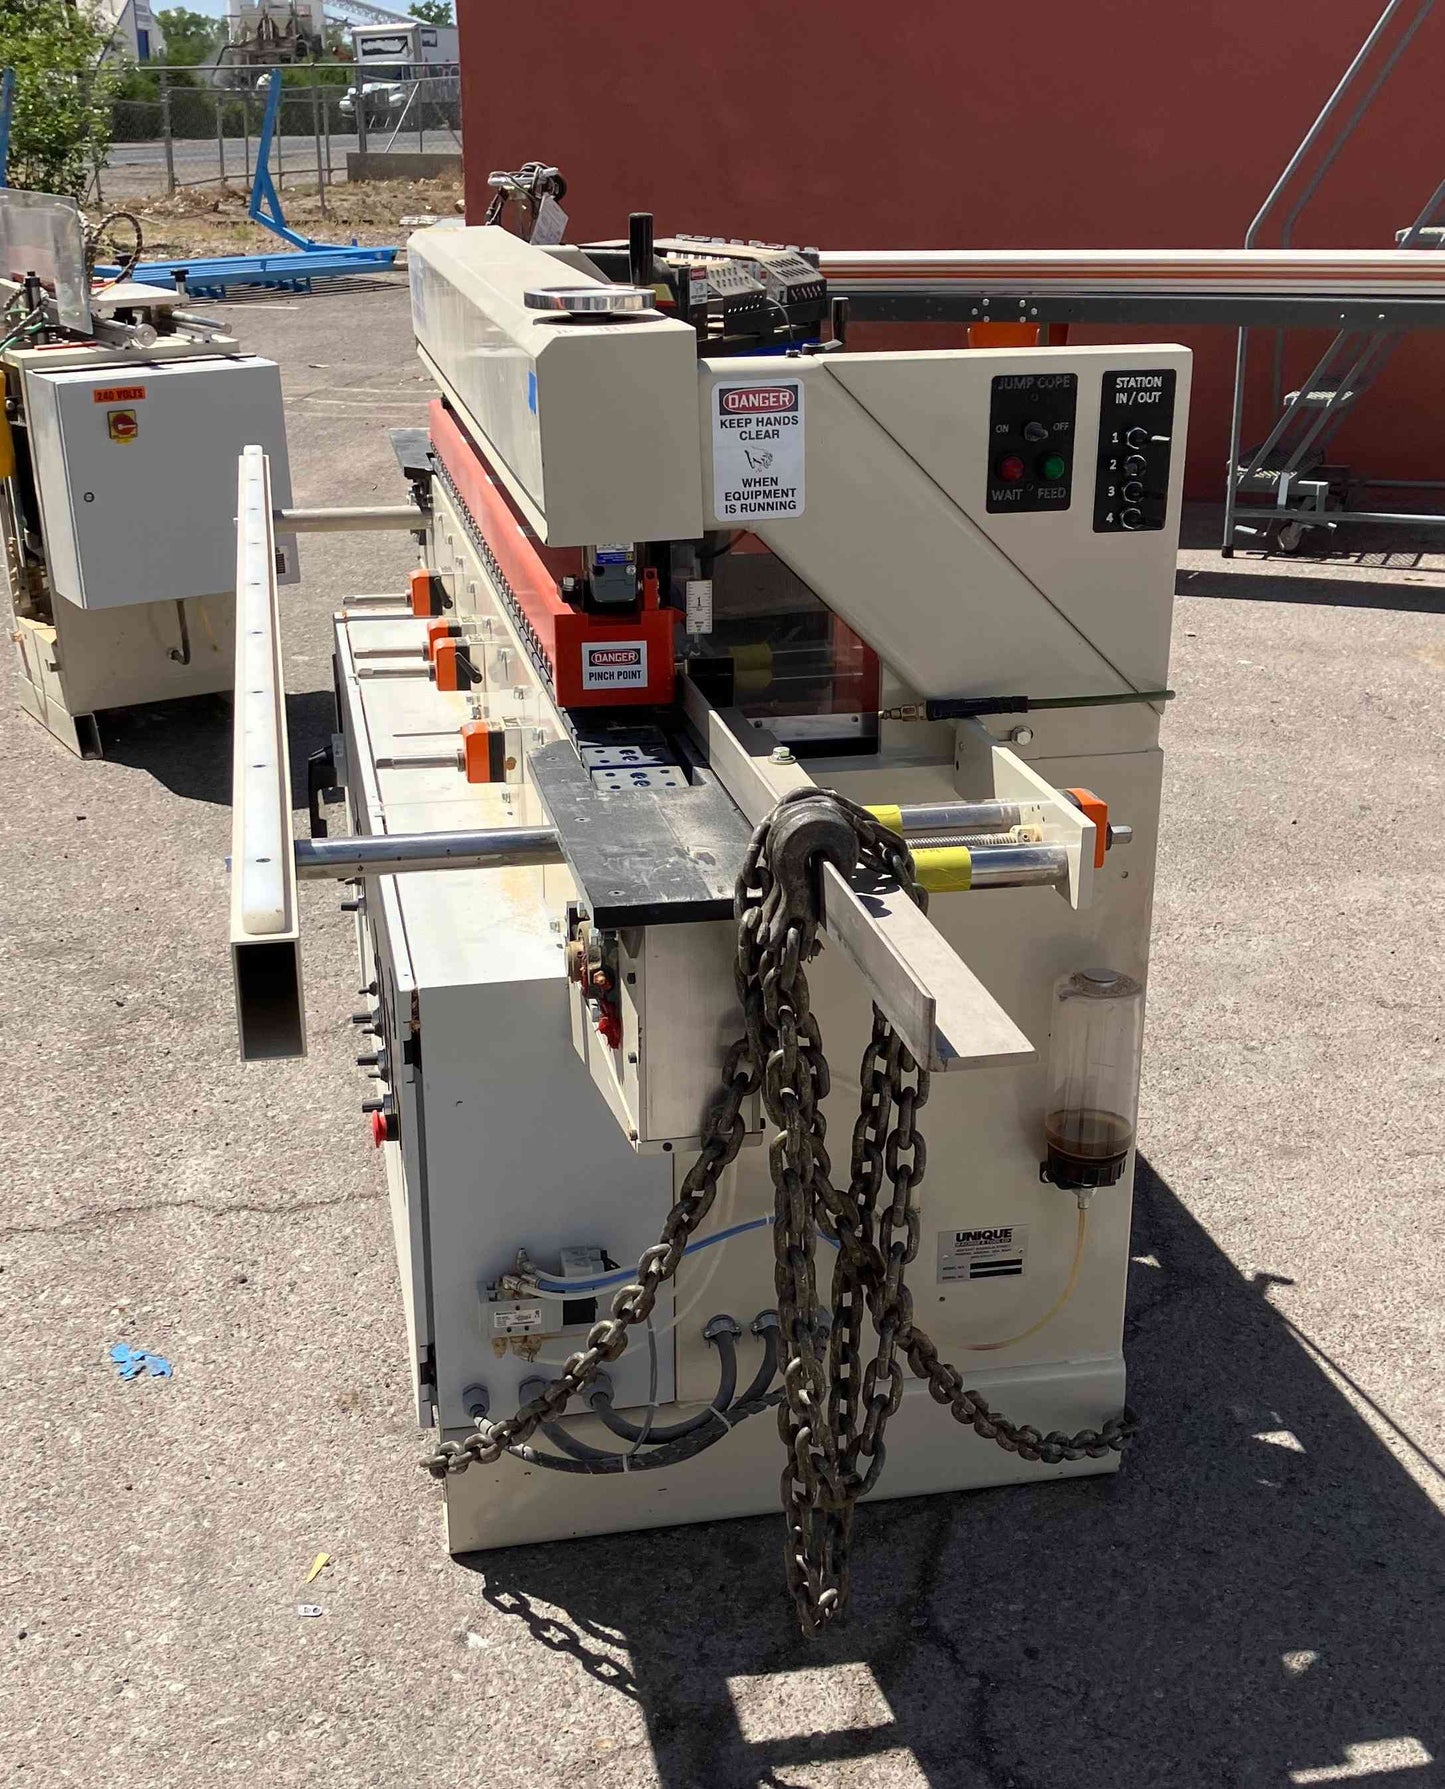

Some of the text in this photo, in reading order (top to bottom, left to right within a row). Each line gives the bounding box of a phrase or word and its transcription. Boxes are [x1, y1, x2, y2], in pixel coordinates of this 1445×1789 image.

[997, 375, 1071, 390] JUMP COPE
[1115, 376, 1163, 389] STATION
[116, 388, 143, 400] VOLTS
[1115, 392, 1128, 404] IN
[1137, 391, 1162, 403] OUT
[728, 392, 790, 409] DANGER
[720, 415, 799, 429] KEEP HANDS
[1053, 422, 1070, 431] OFF
[995, 424, 1010, 433] ON
[739, 429, 780, 441] CLEAR
[1112, 432, 1119, 443] 1
[1109, 459, 1117, 470] 2
[742, 477, 779, 488] WHEN
[725, 488, 797, 502] EQUIPMENT
[992, 489, 1024, 501] WAIT
[1038, 487, 1067, 499] FEED
[1108, 486, 1115, 497] 3
[725, 500, 797, 514] IS RUNNING
[1105, 512, 1114, 523] 4
[594, 652, 636, 663] DANGER
[588, 670, 642, 681] PINCH POINT
[955, 1228, 1013, 1242] UNIQUE
